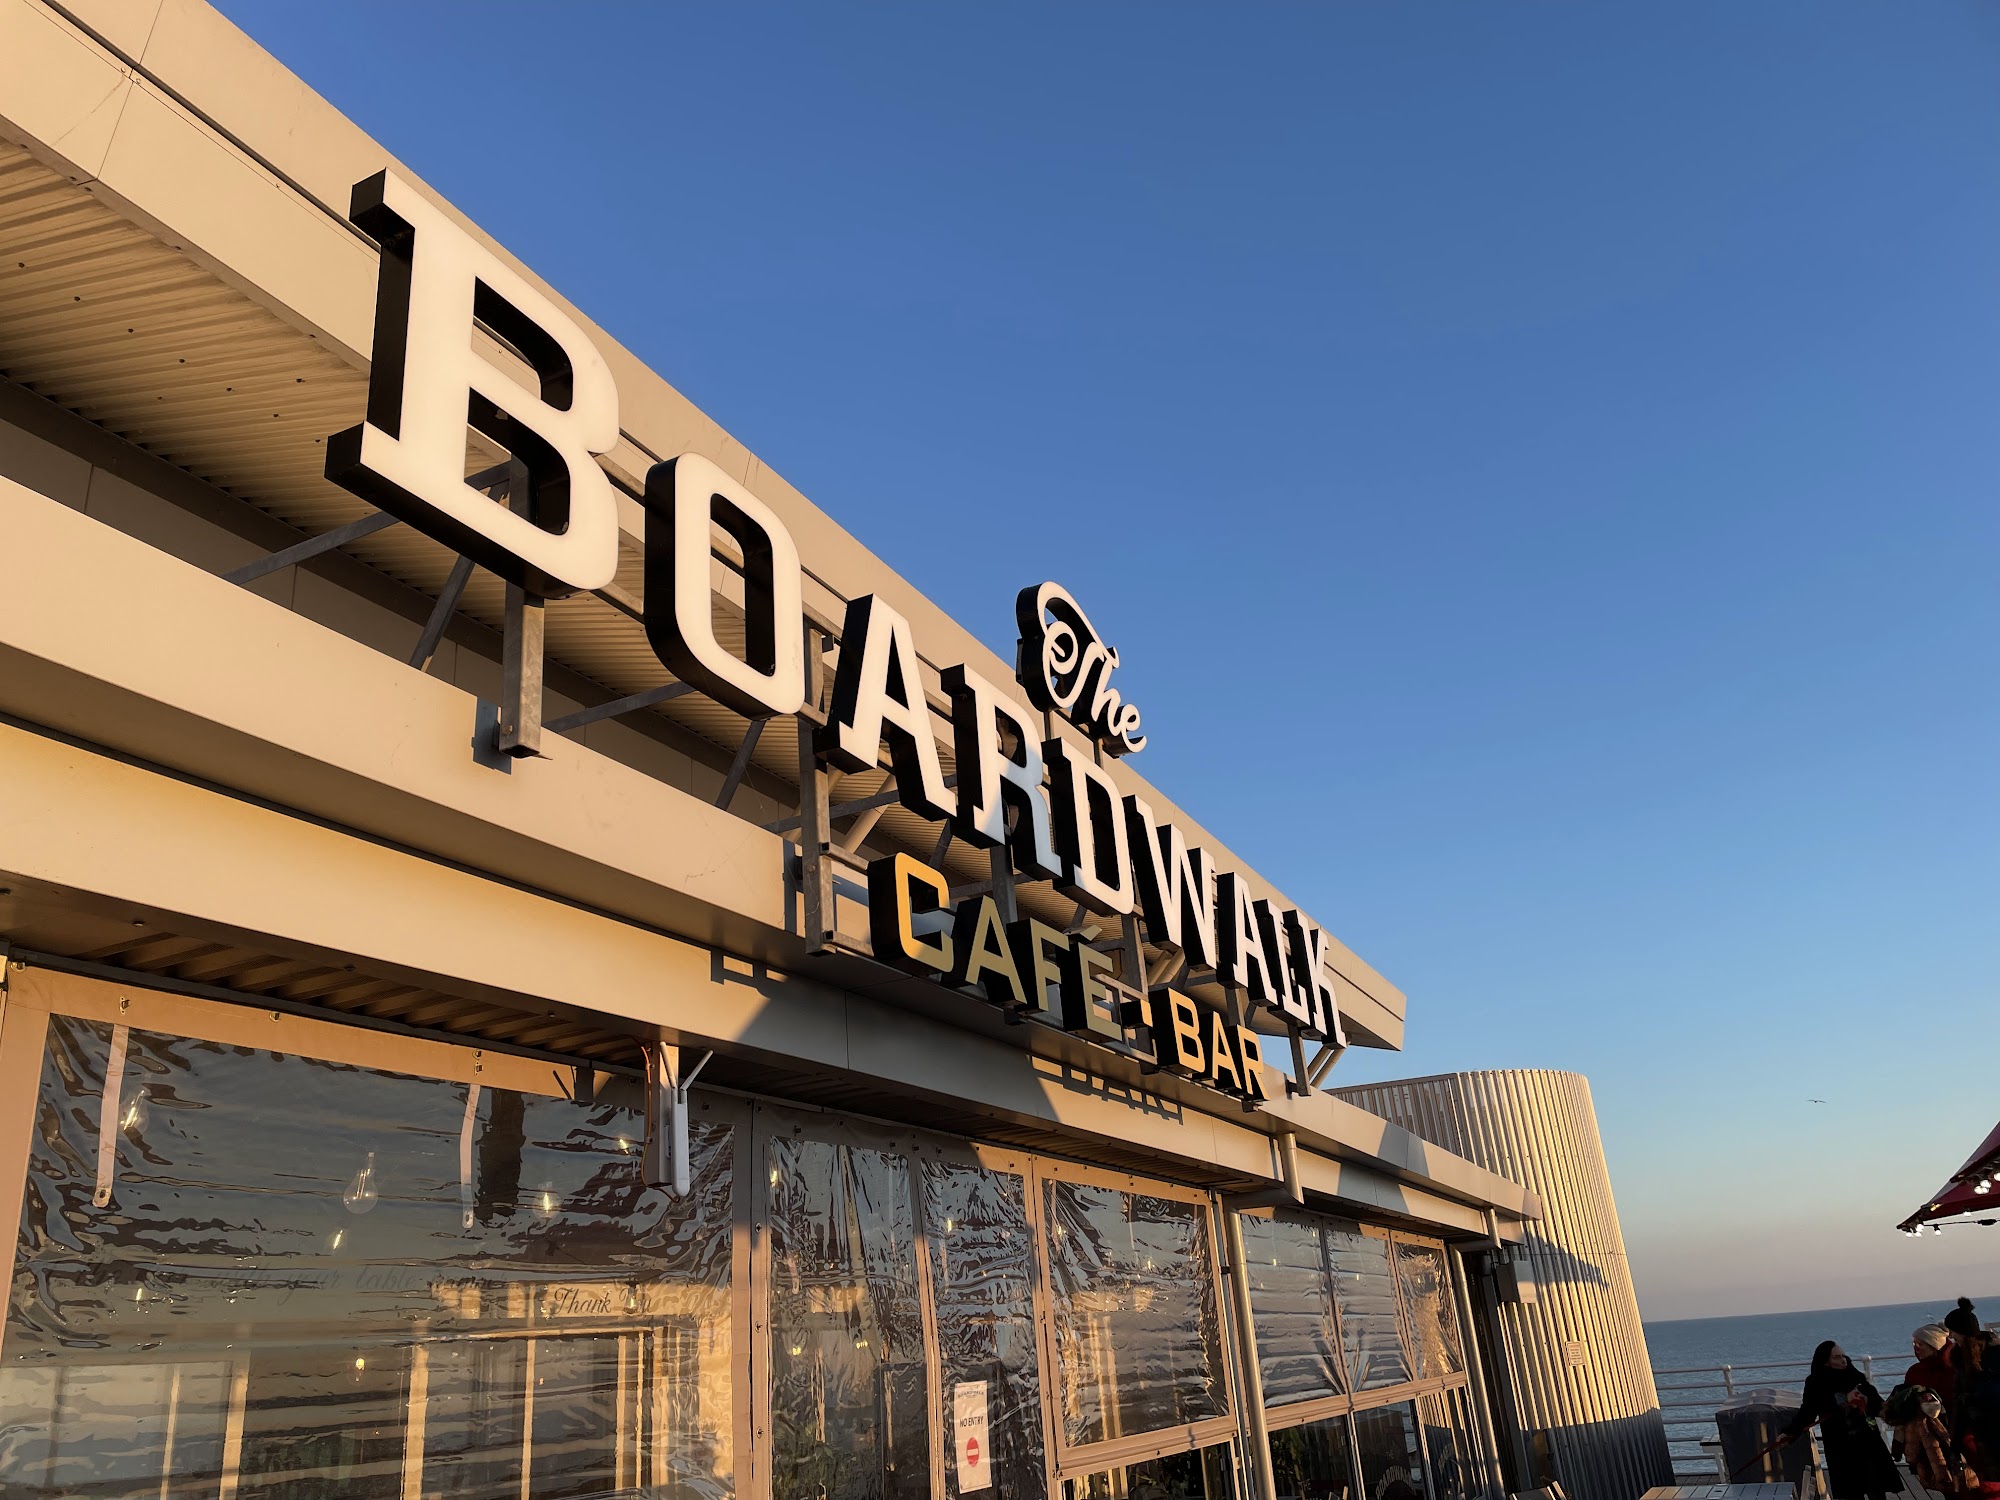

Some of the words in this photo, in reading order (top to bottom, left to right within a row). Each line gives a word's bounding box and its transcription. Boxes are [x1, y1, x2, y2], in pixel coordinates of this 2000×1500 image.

[359, 167, 1347, 1049] BOARDWALK
[1034, 580, 1148, 754] The
[893, 851, 1124, 1043] CAFÉ
[1167, 986, 1271, 1101] BAR
[553, 1286, 612, 1315] Thank
[959, 1417, 968, 1428] NO
[968, 1415, 984, 1427] ENTRY
